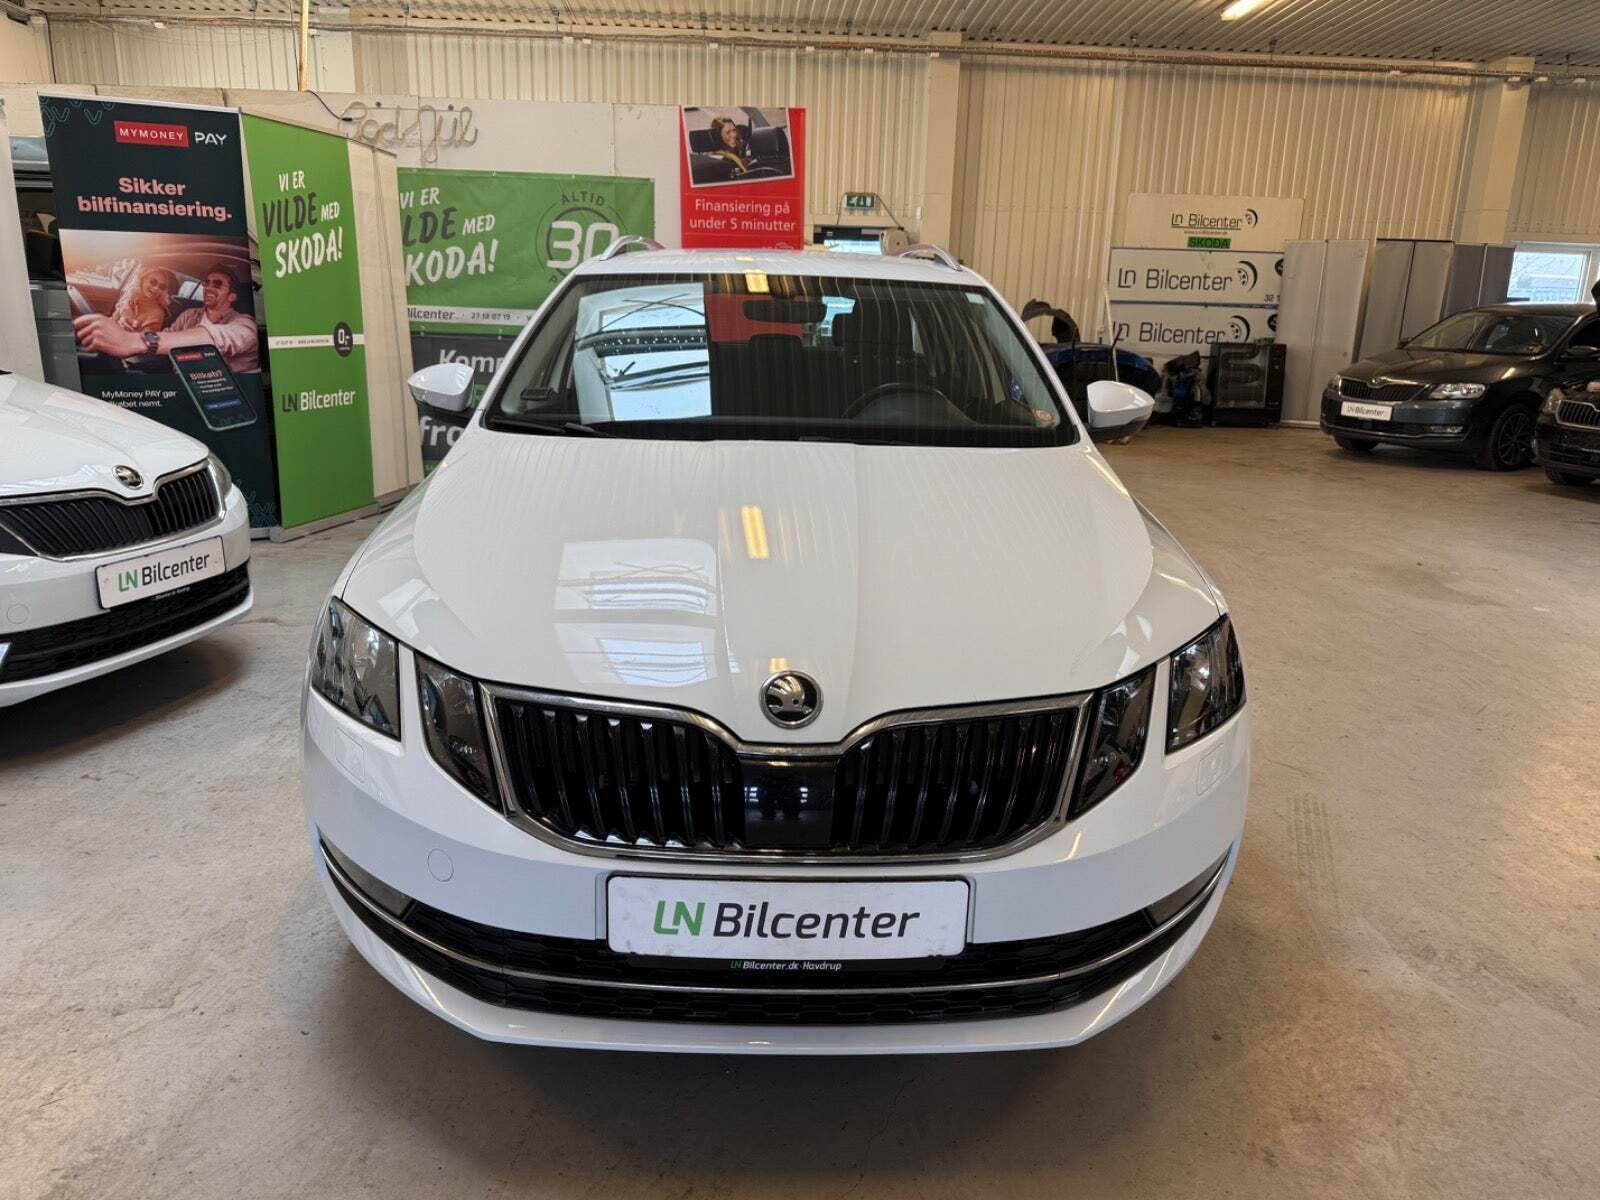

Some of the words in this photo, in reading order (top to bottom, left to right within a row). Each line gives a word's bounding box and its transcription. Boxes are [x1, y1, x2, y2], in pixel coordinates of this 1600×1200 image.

[119, 128, 184, 140] MYMONEY
[194, 132, 227, 145] PAY
[118, 177, 186, 196] Sikker
[279, 173, 289, 192] VI
[292, 170, 306, 189] ER
[77, 196, 232, 222] bilfinansiering.
[400, 191, 415, 209] VI
[420, 187, 440, 206] ER
[561, 191, 605, 206] ALTID
[695, 199, 771, 216] Finansiering
[774, 201, 790, 216] på
[262, 192, 318, 237] VILDE
[321, 201, 340, 222] MED
[689, 217, 728, 230] under
[730, 218, 738, 230] 5
[741, 218, 796, 231] minutter
[1188, 213, 1242, 228] Bilcenter
[402, 207, 458, 247] LDE
[462, 214, 496, 236] MED
[275, 226, 343, 278] SKODA!
[546, 221, 619, 269] 30
[406, 238, 498, 287] KODA!
[1145, 268, 1233, 291] Bilcenter
[1139, 322, 1226, 344] Bilcenter
[101, 391, 143, 400] MyMoney
[300, 390, 356, 411] Bilcenter
[118, 570, 138, 592] LN
[142, 554, 210, 586] Bilcenter
[653, 900, 705, 936] LN
[713, 901, 920, 939] Bilcenter
